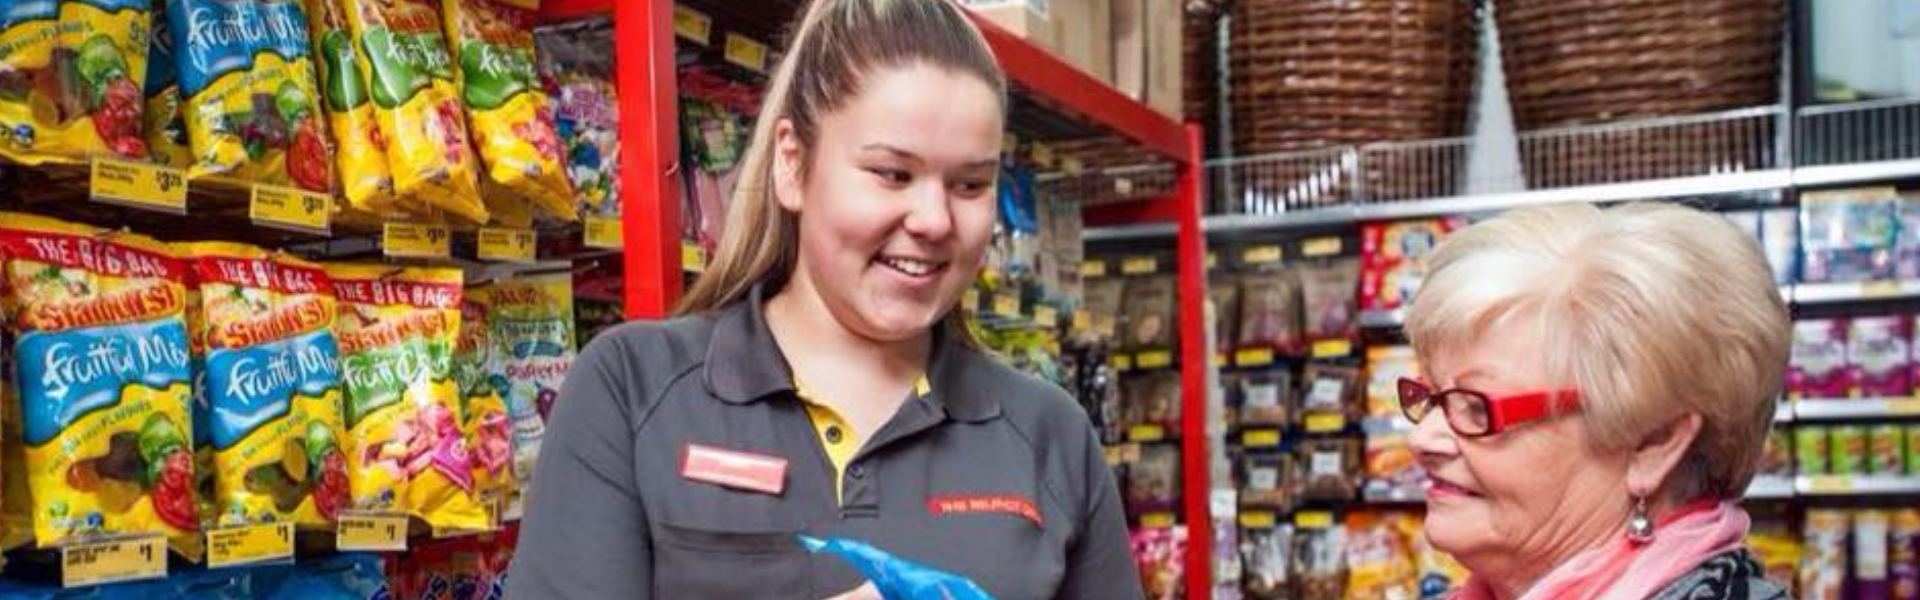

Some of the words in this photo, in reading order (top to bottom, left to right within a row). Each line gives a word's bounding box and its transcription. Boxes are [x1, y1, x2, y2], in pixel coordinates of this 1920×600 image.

[26, 237, 73, 266] THE
[78, 238, 123, 275] BIG
[216, 259, 252, 285] THE
[333, 283, 369, 302] THE
[371, 282, 410, 305] BIG
[137, 332, 190, 374] Mix
